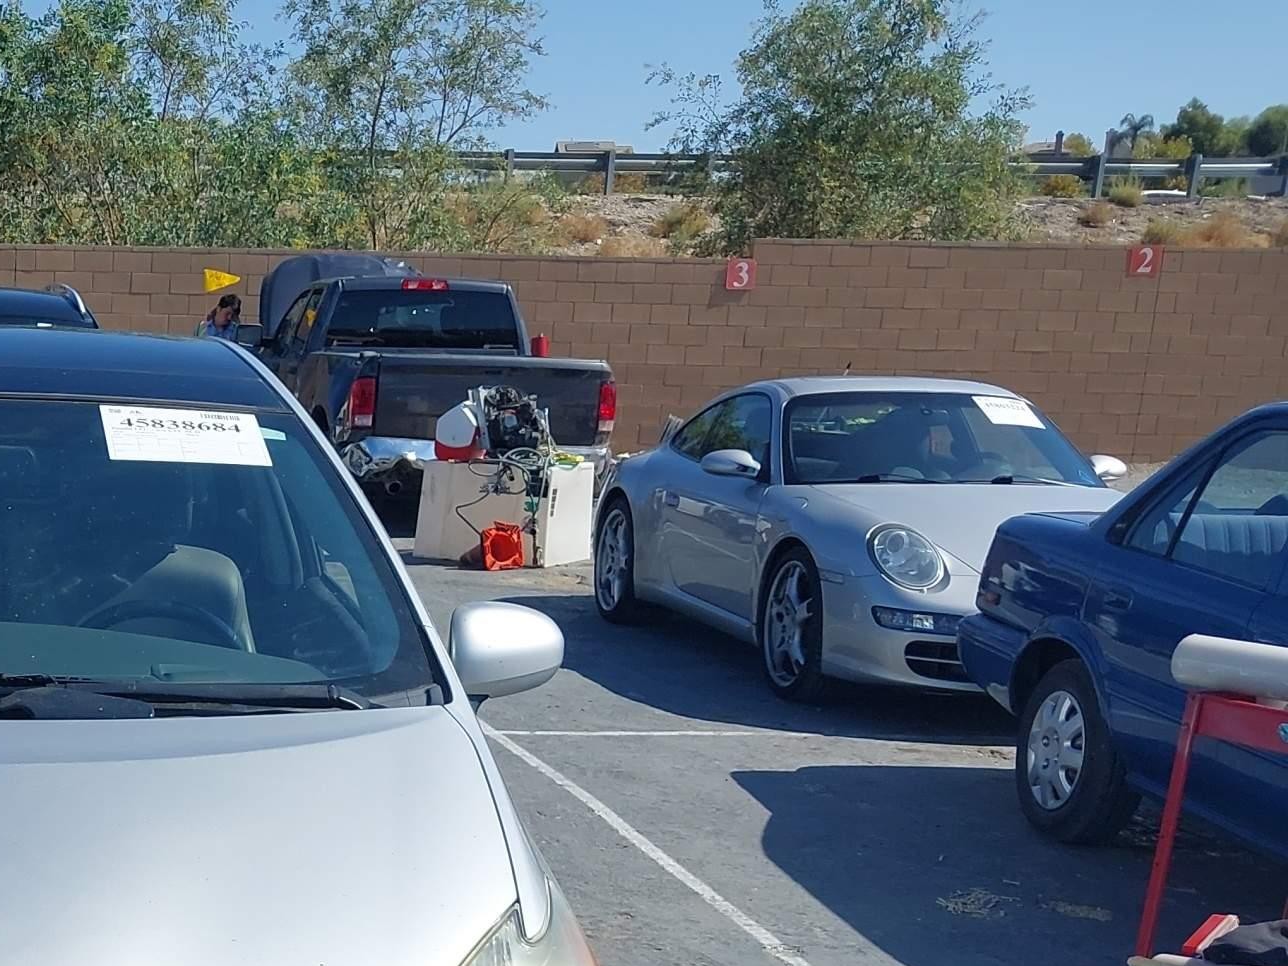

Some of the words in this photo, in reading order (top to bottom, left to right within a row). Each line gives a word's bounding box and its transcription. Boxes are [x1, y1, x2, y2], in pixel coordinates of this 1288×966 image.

[1136, 247, 1154, 273] 2
[732, 261, 750, 288] 3
[119, 417, 242, 434] 45838684
